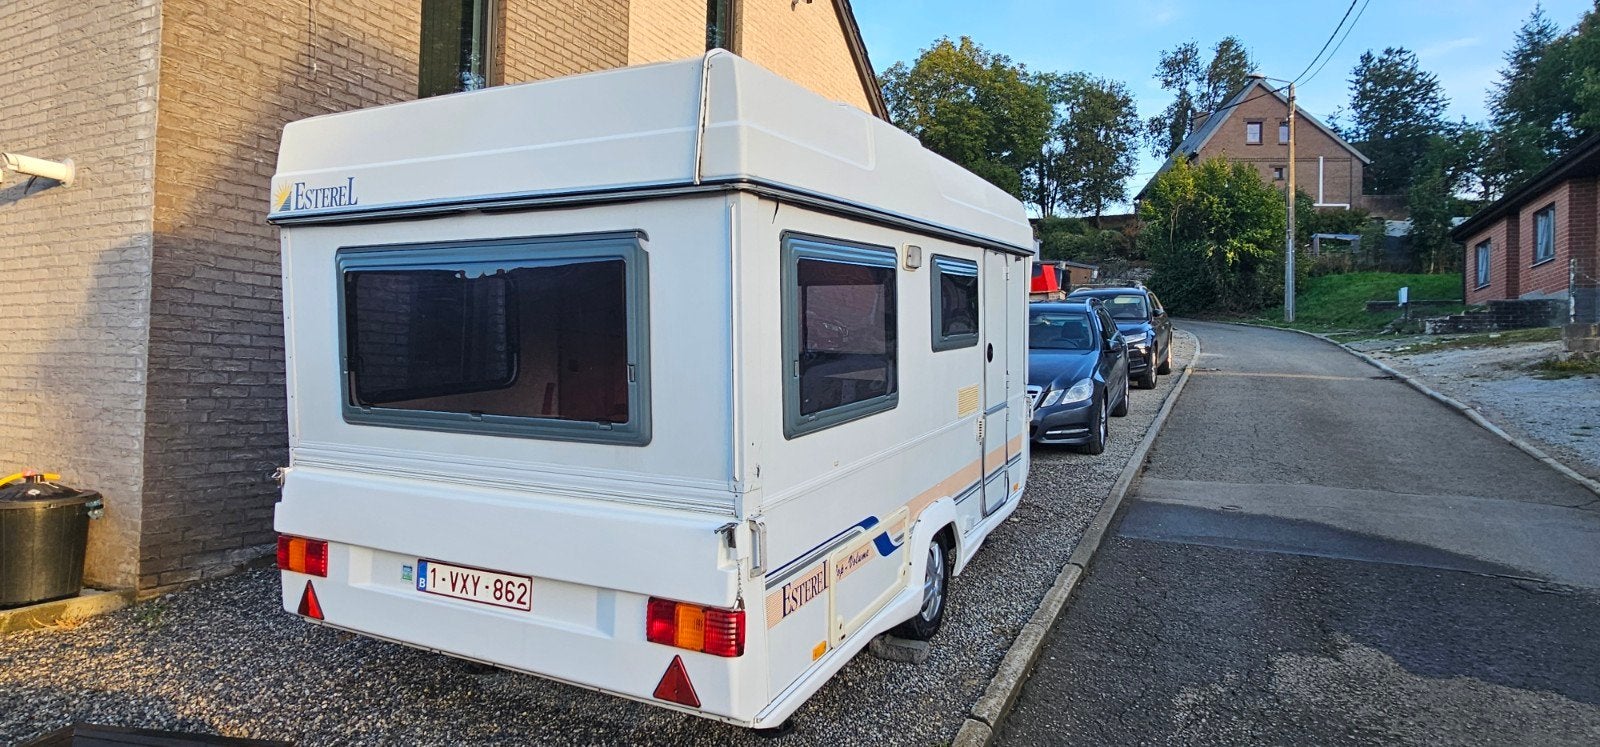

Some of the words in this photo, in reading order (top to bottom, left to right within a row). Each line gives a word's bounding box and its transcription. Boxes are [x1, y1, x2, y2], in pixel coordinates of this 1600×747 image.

[293, 176, 358, 211] ESTEREL
[420, 577, 426, 588] B
[430, 567, 527, 605] 1-VXY-862
